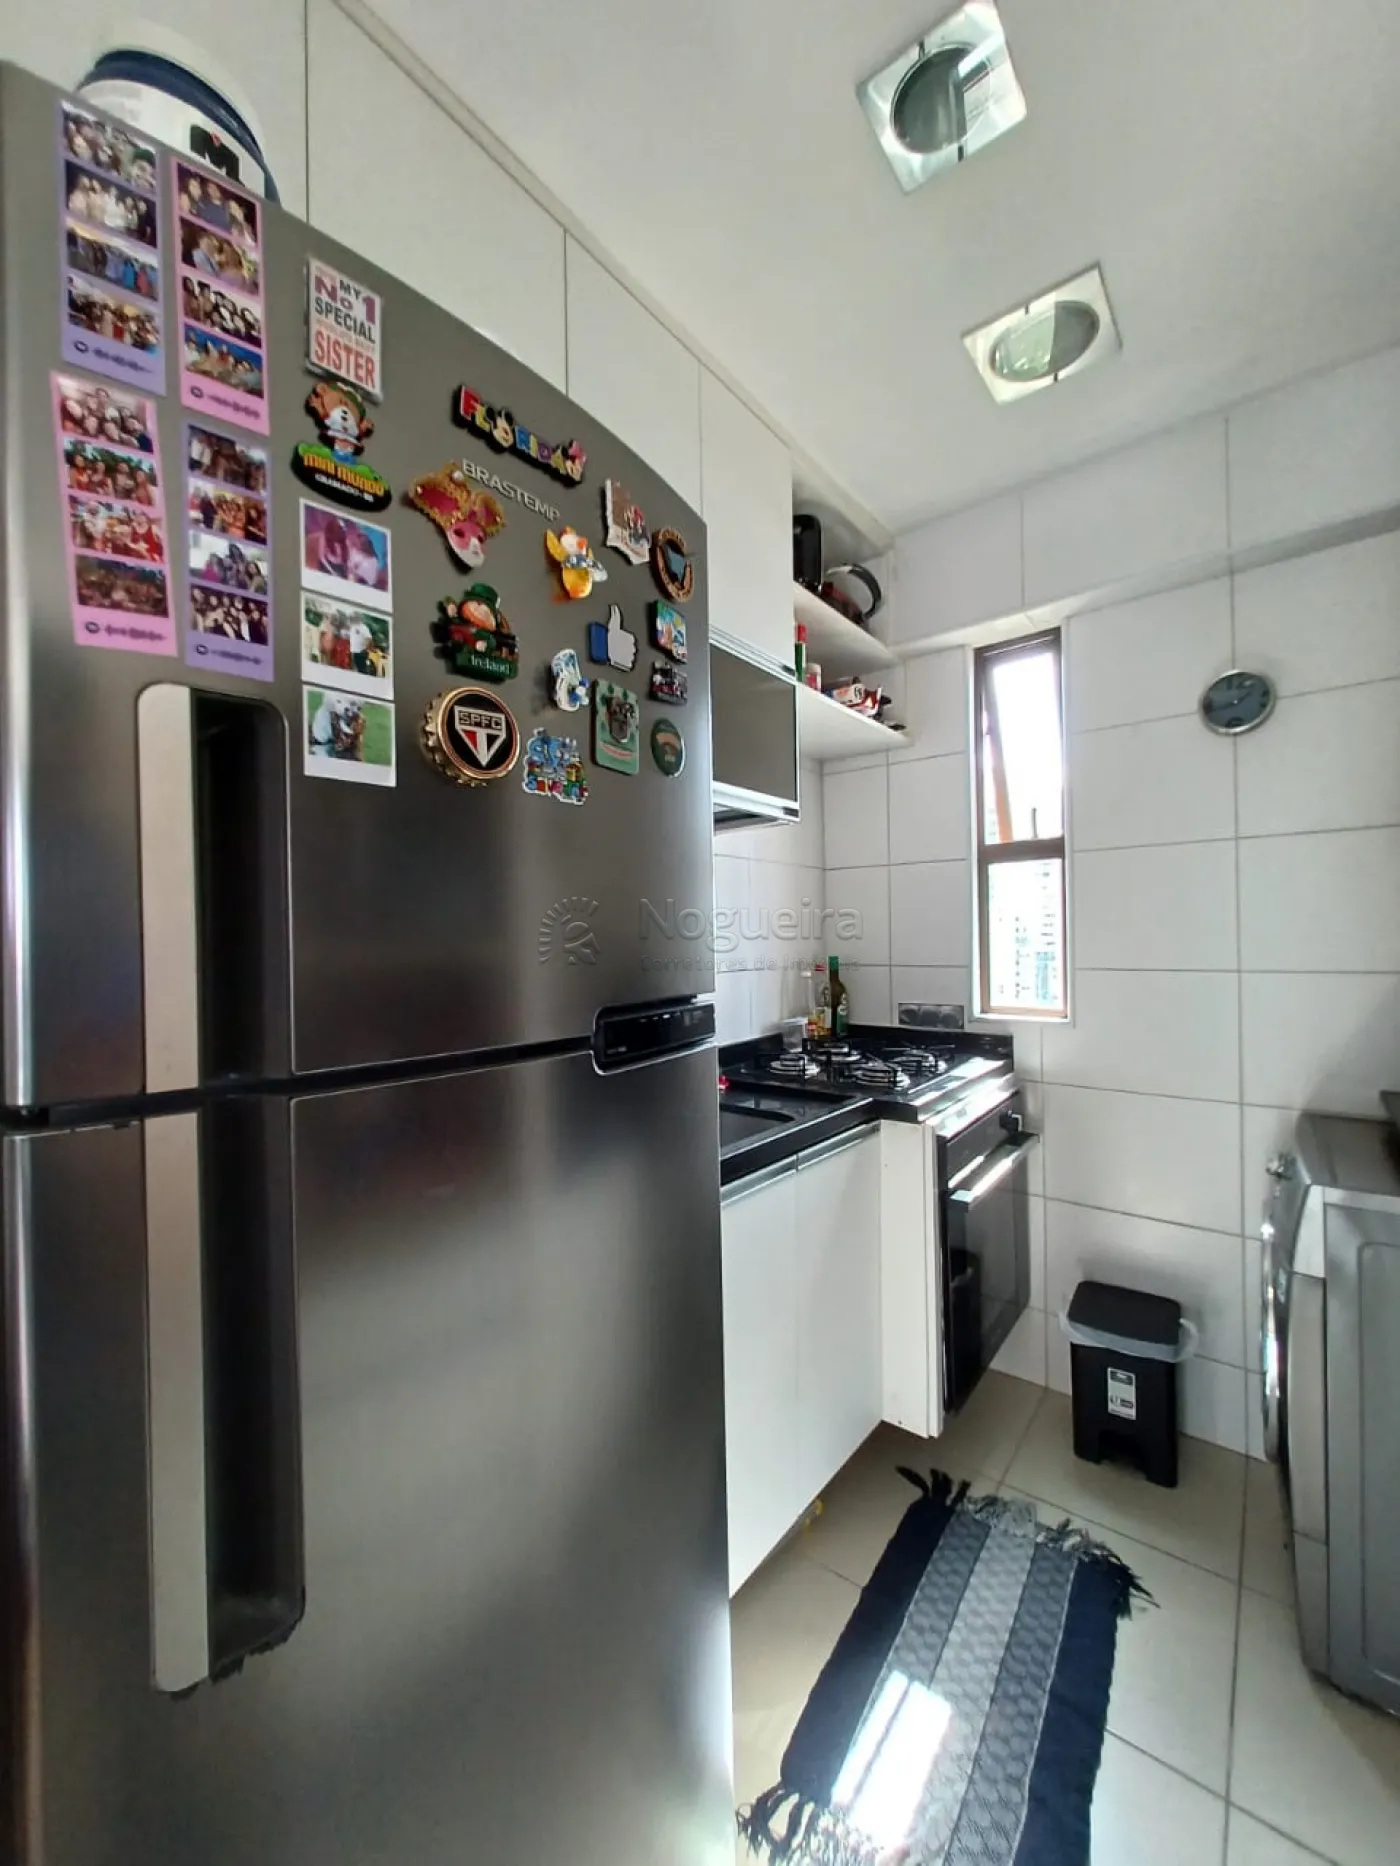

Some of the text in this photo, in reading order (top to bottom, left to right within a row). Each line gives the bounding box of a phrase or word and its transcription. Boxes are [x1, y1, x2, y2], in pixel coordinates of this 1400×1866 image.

[340, 279, 360, 300] MY
[315, 297, 376, 344] SPECIAL
[315, 329, 376, 389] SISTER
[463, 459, 560, 522] BRASTEMP
[471, 654, 510, 675] Ireland
[460, 711, 503, 731] SPFC
